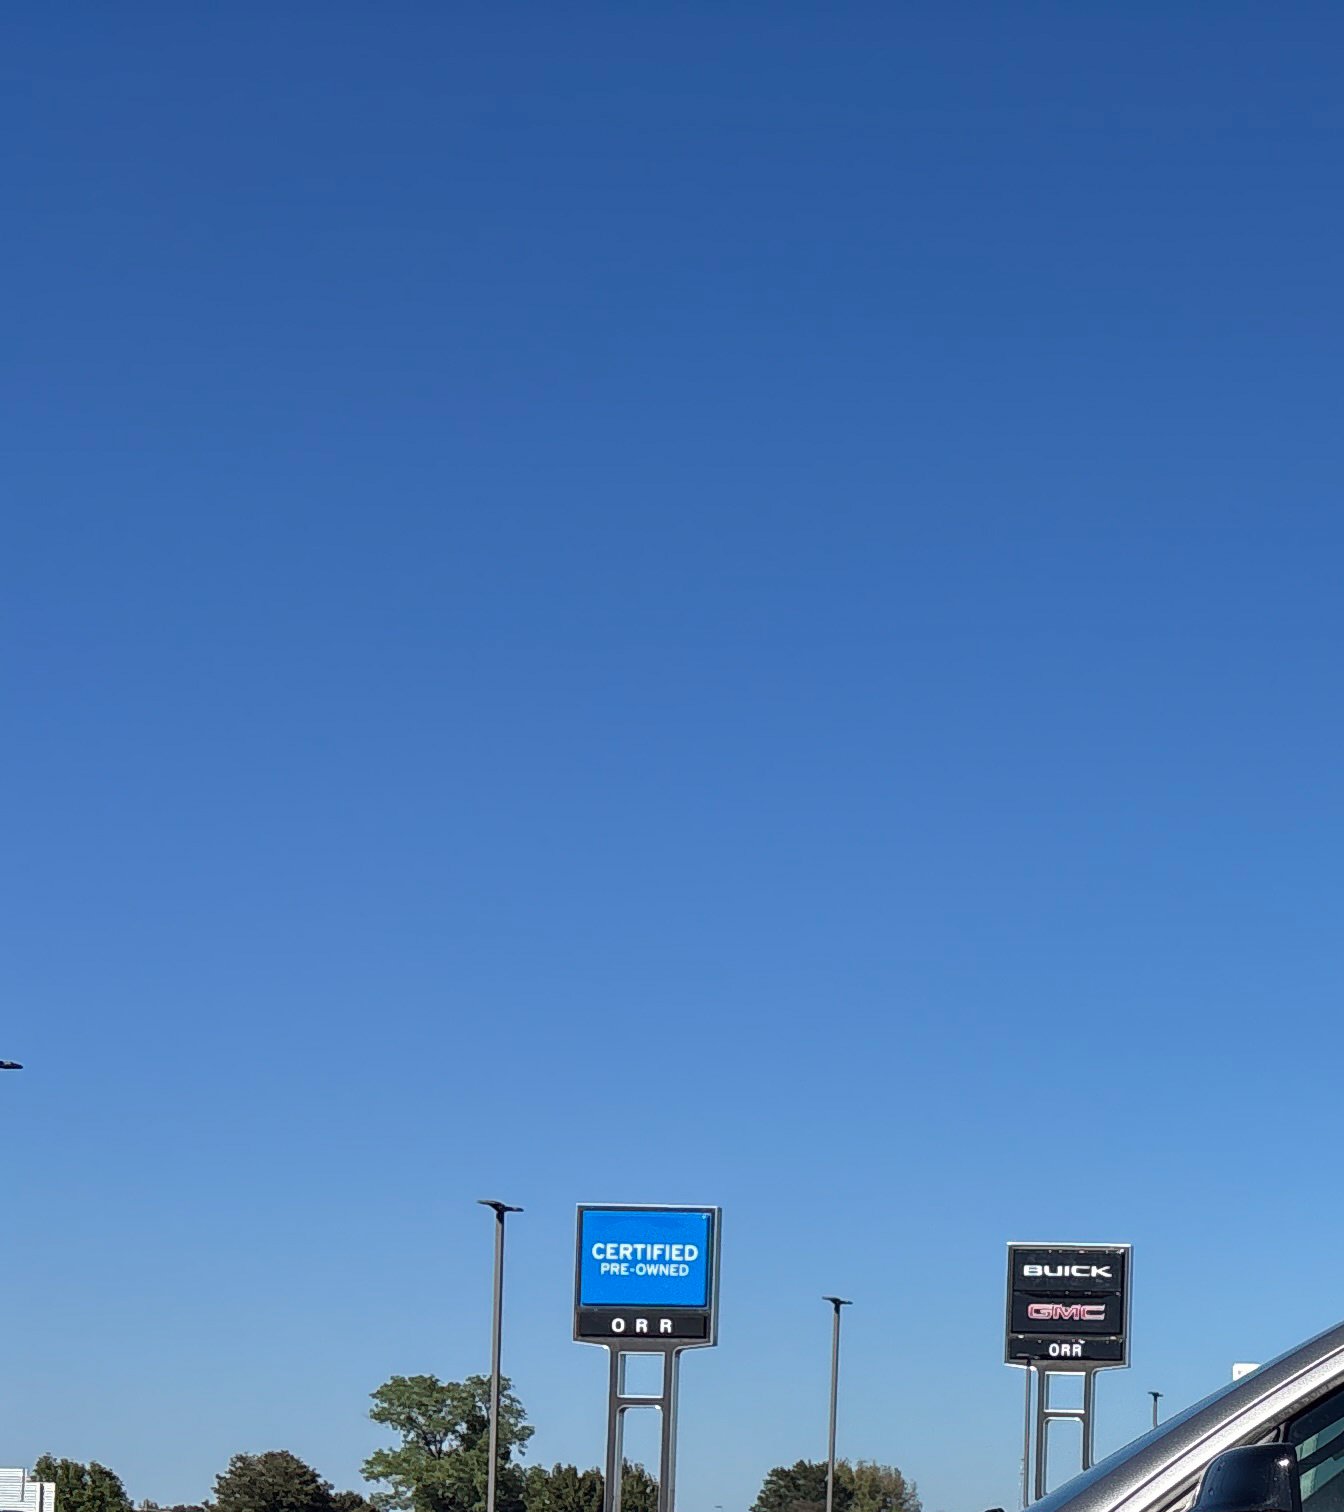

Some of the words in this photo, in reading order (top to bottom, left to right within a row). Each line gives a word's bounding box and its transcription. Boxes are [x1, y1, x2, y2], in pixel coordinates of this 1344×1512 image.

[591, 1242, 699, 1261] CERTIFIED
[600, 1262, 690, 1277] PRE-OWNED
[1023, 1264, 1113, 1278] BUICK
[1027, 1303, 1106, 1321] GMC
[611, 1317, 673, 1334] ORR
[1048, 1343, 1083, 1358] ORR
